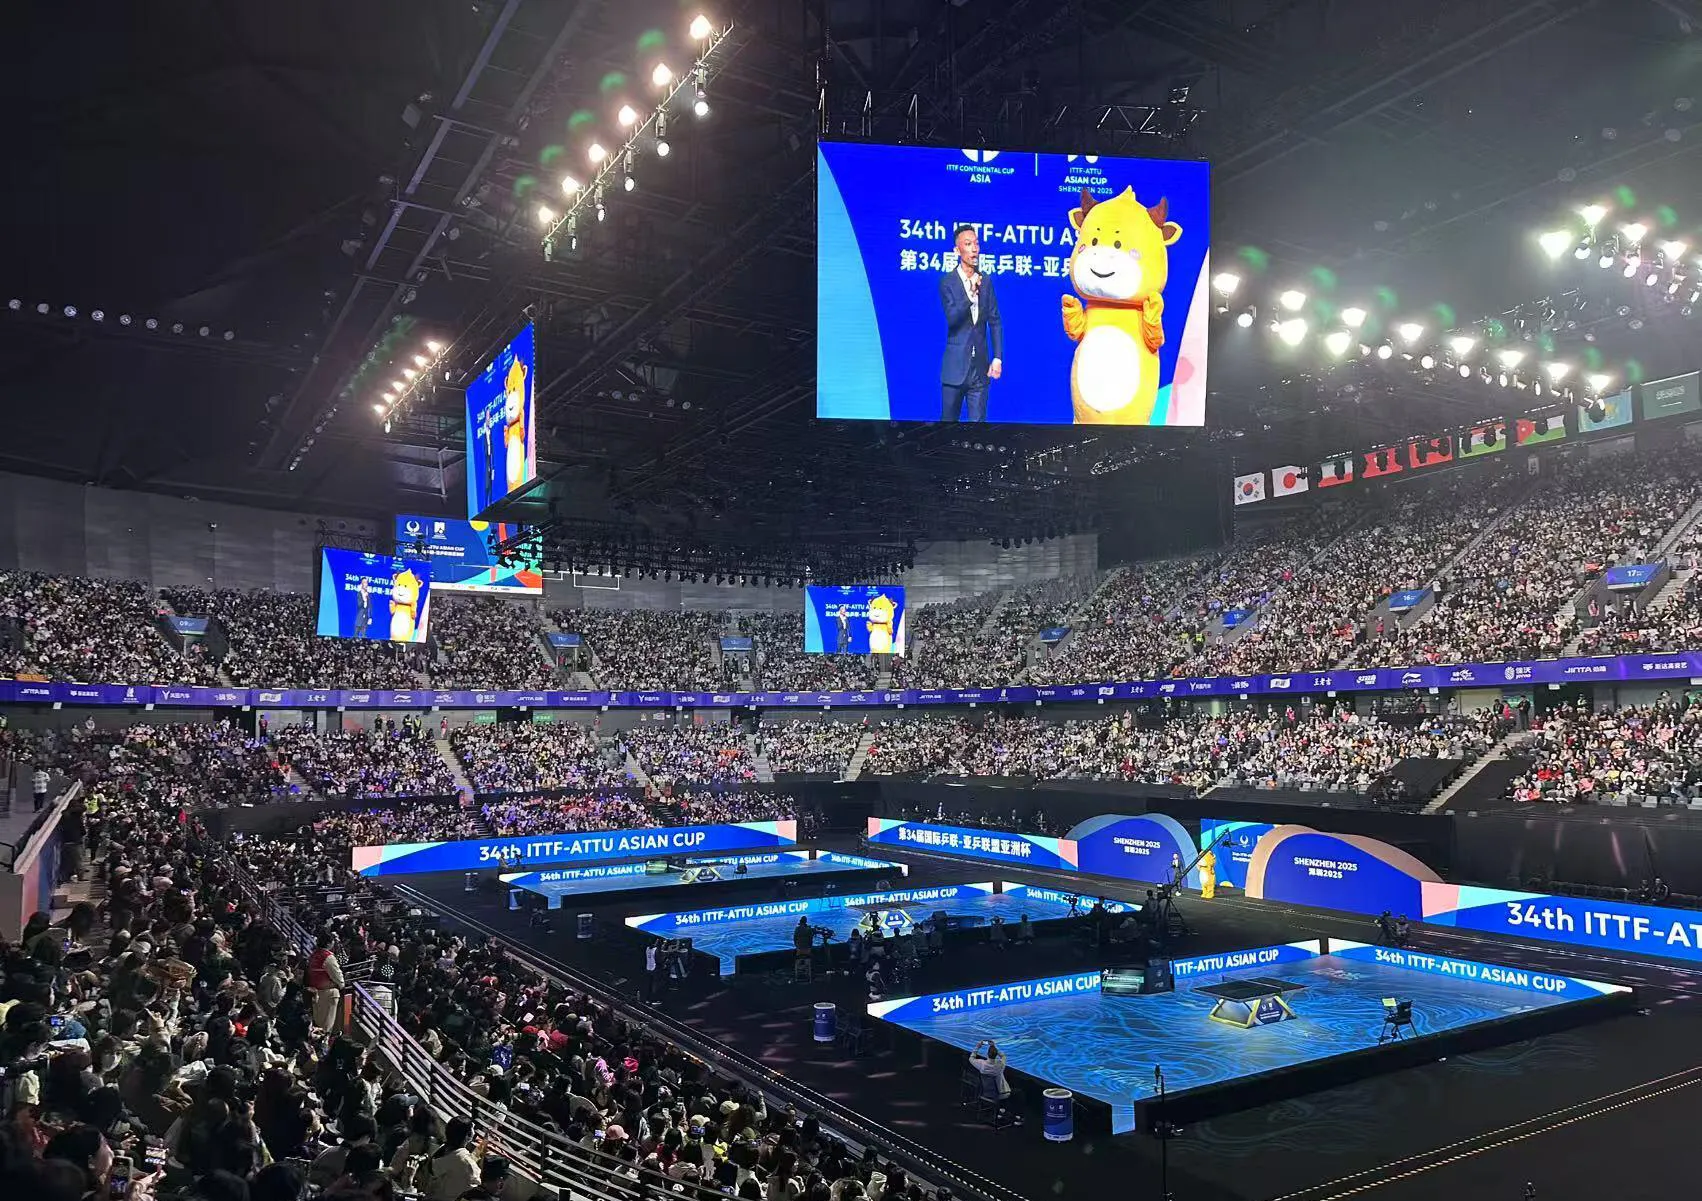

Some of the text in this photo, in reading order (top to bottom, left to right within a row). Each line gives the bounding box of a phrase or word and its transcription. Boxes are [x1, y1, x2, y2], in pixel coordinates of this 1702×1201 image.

[959, 165, 1001, 174] CONTINENTAL
[1001, 167, 1015, 175] CUP
[970, 174, 991, 183] ASIA
[1069, 167, 1102, 175] ITTF-ATTU
[1064, 176, 1108, 185] ASIAN CUP
[1097, 187, 1113, 195] 2025
[900, 219, 946, 240] 34th
[479, 831, 705, 861] 34th ITTF-ATTU ASIAN CUP
[898, 826, 1032, 858] 第34届国际乒联-亚乒联盟亚洲杯
[1113, 837, 1161, 849] SHENZHEN 2025
[739, 855, 763, 865] ASIAN
[764, 854, 778, 863] CUP
[1294, 857, 1358, 871] SHENZHEN 2025
[540, 872, 560, 882] 34th
[562, 868, 605, 879] ITTF-ATTU
[606, 865, 632, 875] ASIAN
[844, 888, 958, 906] 34th ITTF-ATTU ASIAN CUP
[1026, 888, 1042, 897] 34th
[675, 901, 809, 925] 34th ITTF-ATTU ASIAN CUP
[1507, 902, 1574, 932] 34th
[1225, 952, 1257, 968] ASIAN
[1258, 949, 1279, 962] CUP
[1375, 949, 1567, 993] 34th ITTF-ATTU ASIAN CUP
[932, 997, 964, 1012] 34th
[967, 985, 1032, 1007] ITTF-ATTU
[1035, 978, 1073, 996] ASIAN
[1075, 974, 1101, 991] CUP
